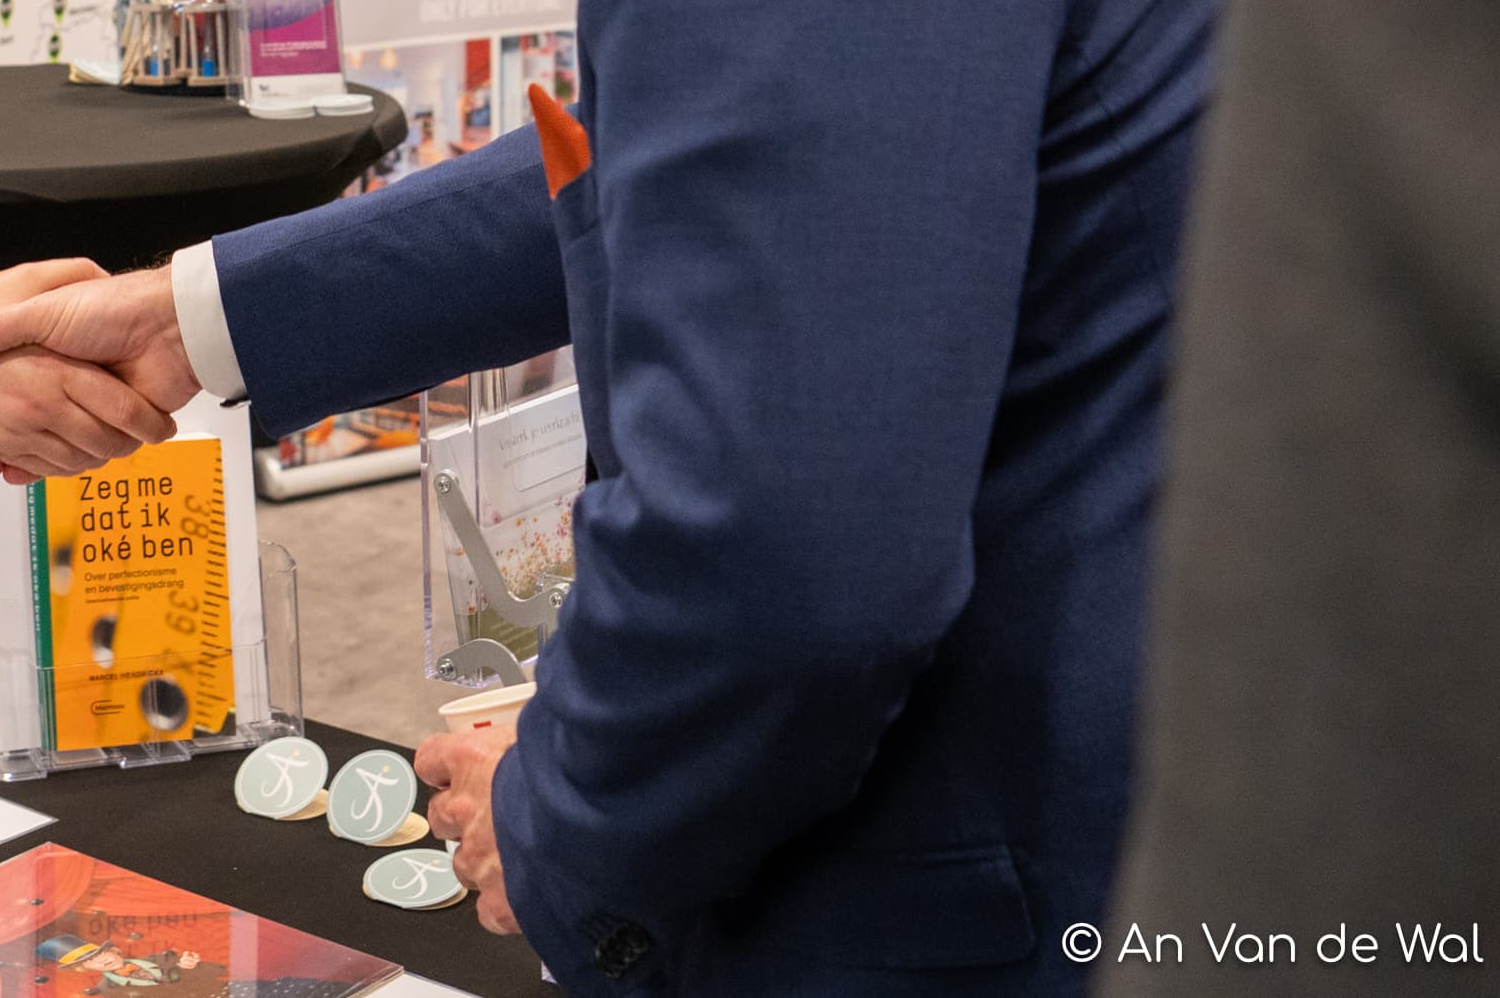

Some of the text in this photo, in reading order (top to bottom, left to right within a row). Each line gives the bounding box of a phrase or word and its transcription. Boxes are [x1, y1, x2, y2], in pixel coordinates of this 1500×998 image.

[79, 476, 173, 505] Zeg me
[81, 502, 171, 532] dat ik
[83, 534, 193, 562] oké ben
[84, 568, 178, 581] Over perfectionisme
[85, 586, 97, 594] en
